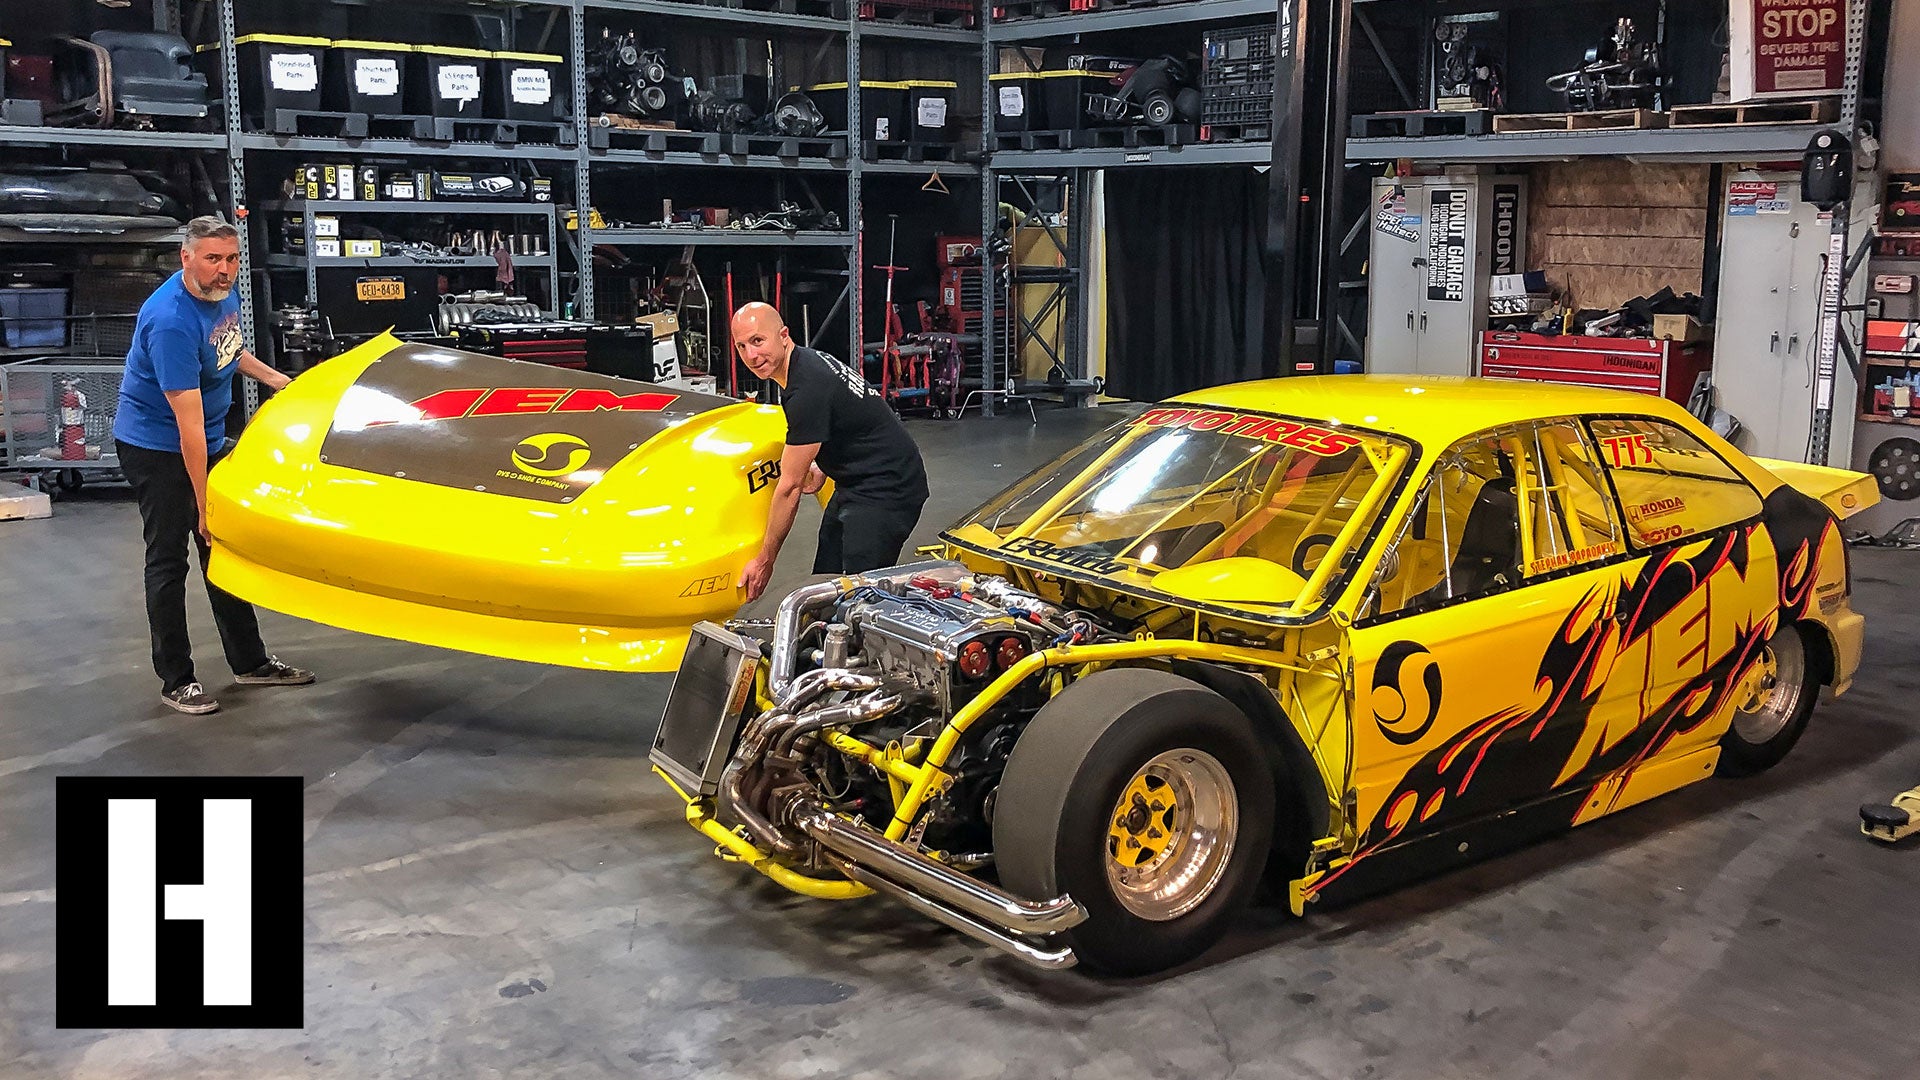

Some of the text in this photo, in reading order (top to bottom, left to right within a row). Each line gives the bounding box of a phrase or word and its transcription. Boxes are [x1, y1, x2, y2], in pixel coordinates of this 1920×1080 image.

[1763, 8, 1837, 38] STOP
[1760, 41, 1840, 55] SEVERE TIRE
[1774, 54, 1826, 68] DAMAGE
[516, 76, 534, 84] BMW
[1730, 182, 1777, 190] RACELINE
[1378, 220, 1421, 241] Haltech
[1428, 203, 1440, 287] LONG BEACH CALIFORNIA
[1437, 203, 1449, 288] HOONIGAN INDUSTRIES
[1445, 192, 1467, 300] DONUT GARAGE
[361, 284, 401, 297] GEU-8438
[1125, 407, 1365, 457] TOYO TIRES
[1601, 434, 1654, 469] 775
[496, 469, 570, 490] DVS SHOE COMPANY
[1640, 496, 1685, 515] HONDA
[1640, 524, 1683, 543] TOYO
[1530, 553, 1568, 574] STEPHAN
[678, 572, 731, 598] AEM
[1550, 521, 1779, 789] AEM
